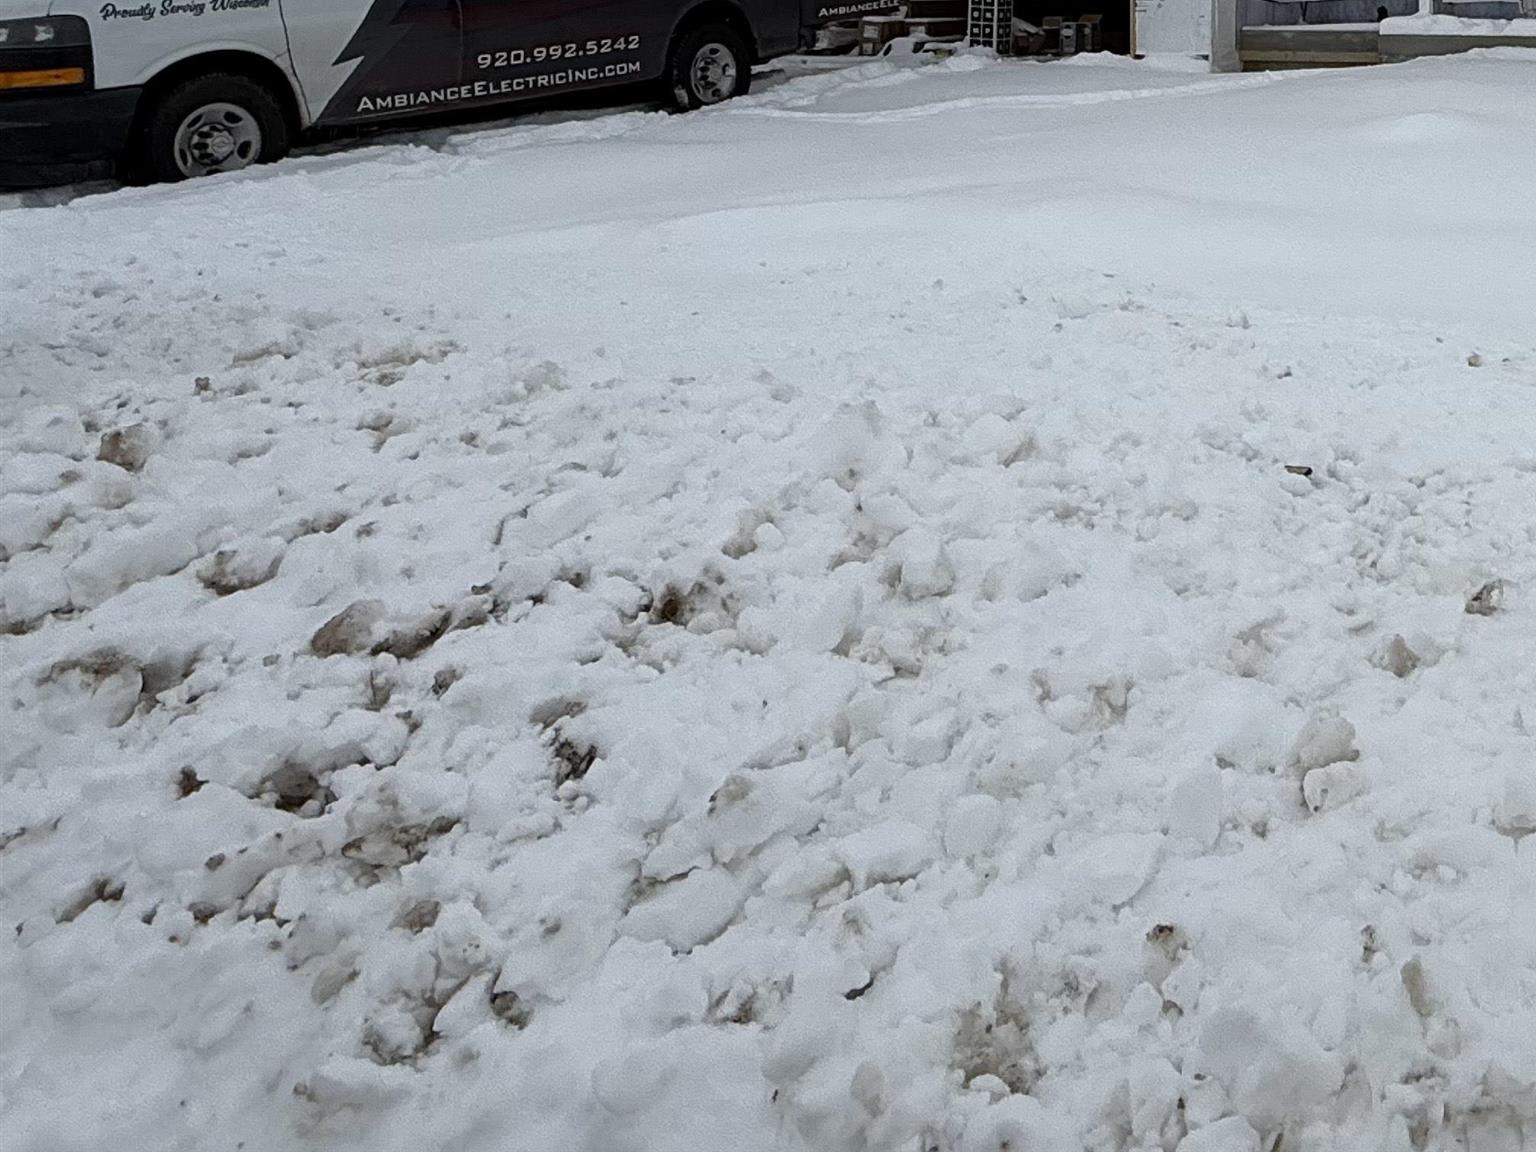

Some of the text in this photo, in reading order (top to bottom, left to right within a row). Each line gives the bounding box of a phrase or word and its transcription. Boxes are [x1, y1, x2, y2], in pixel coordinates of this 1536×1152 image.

[100, 3, 157, 20] Proudly
[160, 0, 206, 16] Serving
[477, 35, 640, 69] 920.992.5242
